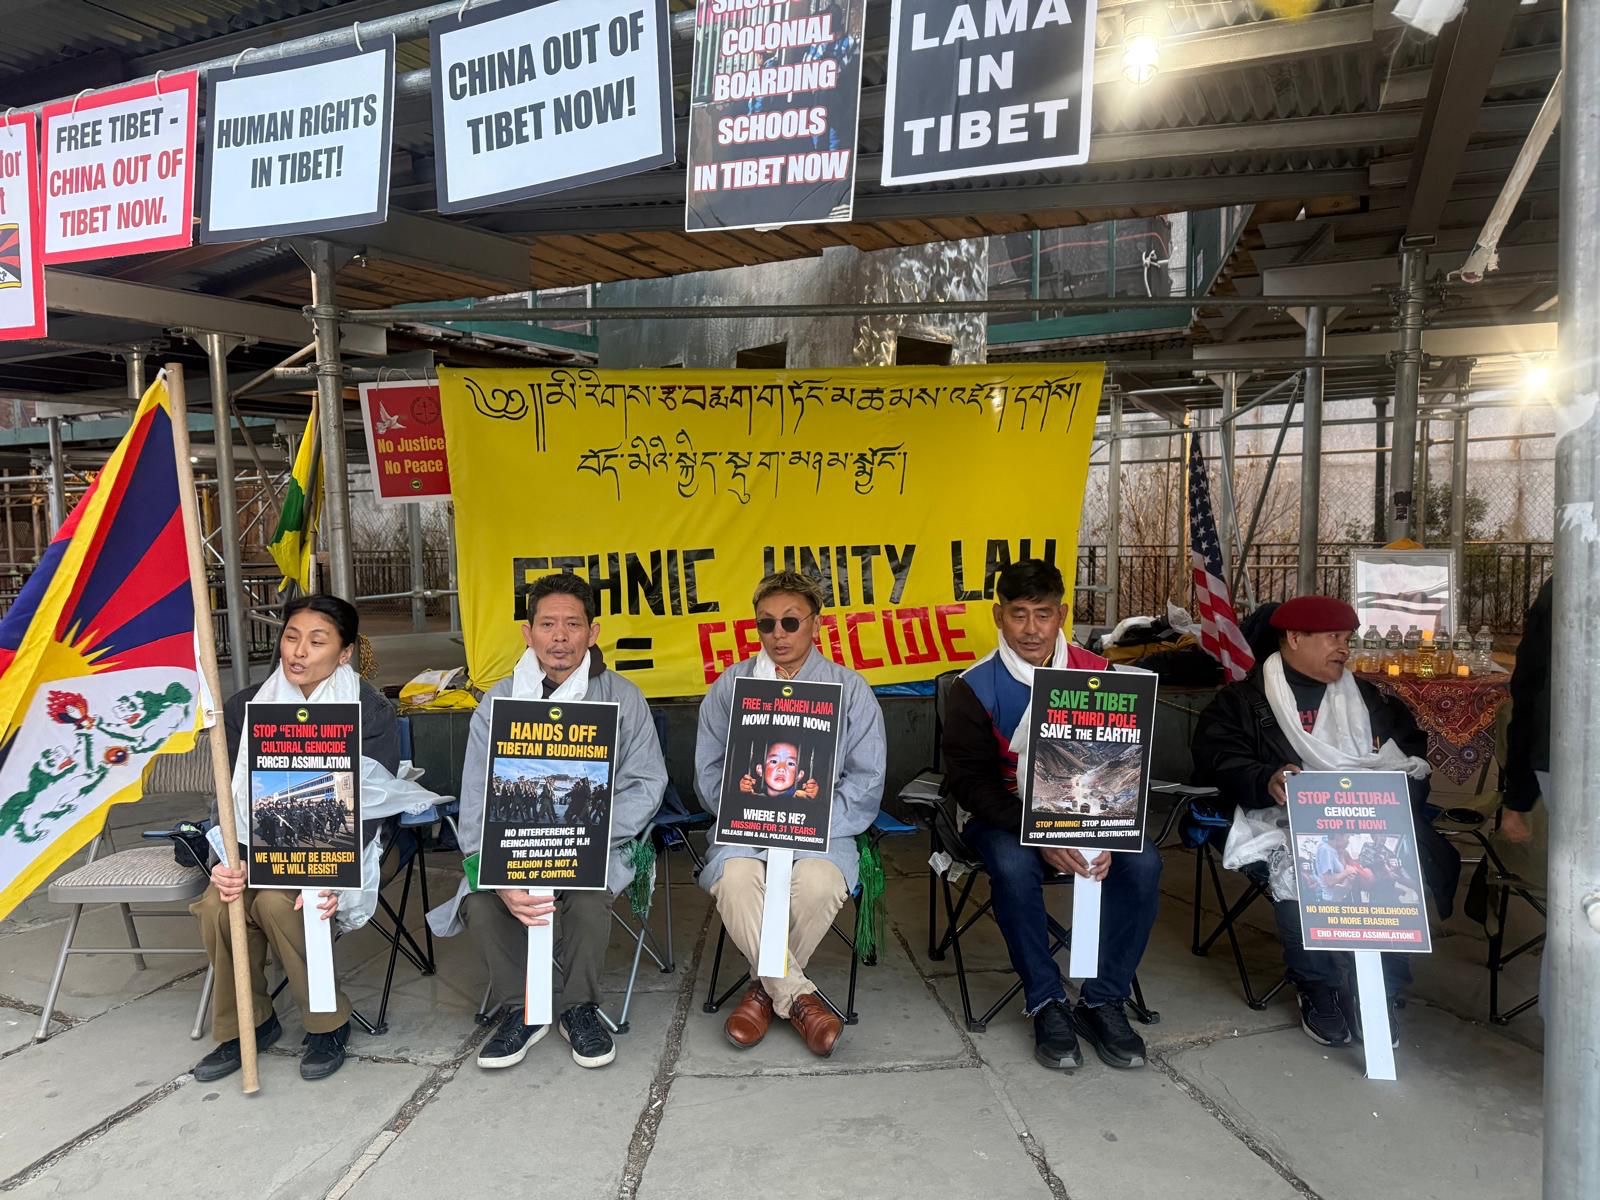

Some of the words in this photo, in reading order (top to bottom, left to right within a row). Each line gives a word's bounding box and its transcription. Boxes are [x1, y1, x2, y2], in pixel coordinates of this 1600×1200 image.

[911, 0, 1072, 51] LAMA
[722, 14, 833, 56] COLONIAL
[448, 43, 537, 101] CHINA
[542, 24, 600, 76] OUT
[608, 10, 644, 57] OF
[714, 59, 838, 102] BOARDING
[958, 50, 1014, 97] IN
[217, 110, 294, 149] HUMAN
[299, 94, 377, 138] RIGHTS
[467, 102, 546, 155] TIBET
[553, 76, 636, 136] NOW!
[56, 117, 102, 153] FREE
[108, 107, 164, 144] TIBET
[718, 106, 827, 145] SCHOOLS
[904, 98, 1069, 156] TIBET
[50, 163, 106, 197] CHINA
[113, 154, 151, 187] OUT
[158, 148, 183, 181] OF
[251, 157, 272, 188] IN
[279, 146, 343, 185] TIBET!
[694, 165, 717, 191] IN
[721, 156, 785, 189] TIBET
[788, 150, 850, 182] NOW
[60, 205, 111, 237] TIBET
[117, 197, 167, 230] NOW.
[377, 438, 393, 453] No
[397, 435, 445, 452] Justice
[384, 460, 401, 475] No
[404, 459, 444, 474] Peace
[698, 604, 976, 684] GEOCIDE
[742, 697, 762, 710] FREE
[762, 702, 773, 711] THE
[774, 698, 809, 713] PANCHEN
[811, 701, 833, 716] LAMA
[1050, 689, 1089, 709] SAVE
[1094, 692, 1138, 712] TIBET
[742, 714, 770, 726] NOW!
[772, 715, 800, 727] NOW!
[803, 716, 831, 732] NOW!
[1047, 709, 1068, 724] THE
[1072, 711, 1104, 726] THIRD
[1108, 713, 1136, 728] POLE
[253, 724, 276, 738] STOP
[510, 722, 563, 741] HANDS
[568, 724, 597, 743] OFF
[1040, 723, 1072, 739] SAVE
[1075, 729, 1092, 740] THE
[1096, 727, 1140, 743] EARTH!
[261, 741, 303, 753] CULTURAL
[305, 741, 346, 753] GENOCIDE
[497, 742, 542, 756] TIBETAN
[546, 743, 608, 759] BUDDHISM!
[257, 756, 289, 768] FORCED
[291, 756, 351, 769] ASSIMILATION
[1297, 791, 1331, 805] STOP
[1334, 791, 1400, 805] CULTURAL
[744, 808, 775, 823] WHERE
[777, 811, 786, 823] IS
[788, 812, 806, 825] HE?
[1324, 807, 1376, 817] GENOCIDE
[505, 829, 516, 837] NO
[518, 828, 575, 837] INTERFERENCE
[577, 827, 585, 835] IN
[731, 820, 760, 831] MISSING
[763, 823, 777, 832] FOR
[778, 823, 787, 832] 31
[790, 824, 816, 835] YEARS!
[1035, 820, 1053, 828] STOP
[1054, 820, 1080, 828] MINING!
[1101, 819, 1135, 827] DAMMING!
[1316, 819, 1344, 830] STOP
[1346, 819, 1356, 830] IT
[1358, 820, 1387, 830] NOW!
[500, 839, 563, 848] REINCARNATION
[565, 838, 575, 846] OF
[576, 838, 590, 846] H.H
[722, 829, 743, 837] RELEASE
[770, 832, 794, 841] POLITICAL
[795, 835, 824, 844] PRISONERS!
[1046, 831, 1096, 839] ENVIRONMENTAL
[1097, 830, 1140, 838] DESTRUCTION!
[255, 852, 268, 863] WE
[270, 852, 288, 863] WILL
[291, 852, 306, 863] NOT
[308, 852, 319, 863] BE
[321, 852, 354, 863] ERASED!
[512, 850, 527, 858] THE
[529, 849, 553, 858] DALAI
[554, 849, 577, 857] LAMA
[272, 864, 285, 875] WE
[287, 864, 306, 875] WILL
[308, 863, 338, 875] RESIST!
[507, 860, 543, 869] RELIGION
[545, 860, 553, 868] IS
[554, 859, 571, 868] NOT
[572, 859, 578, 867] A
[507, 871, 527, 880] TOOL
[529, 871, 539, 879] OF
[541, 870, 576, 879] CONTROL
[1306, 905, 1317, 913] NO
[1318, 906, 1340, 914] MORE
[1341, 906, 1369, 914] STOLEN
[1370, 907, 1418, 916] CHILDHOODS!
[1328, 917, 1339, 925] NO
[1340, 917, 1362, 925] MORE
[1363, 917, 1399, 926] ERASURE!
[1317, 929, 1332, 937] END
[1333, 930, 1361, 938] FORCED
[1362, 930, 1414, 940] ASSIMILATION!
